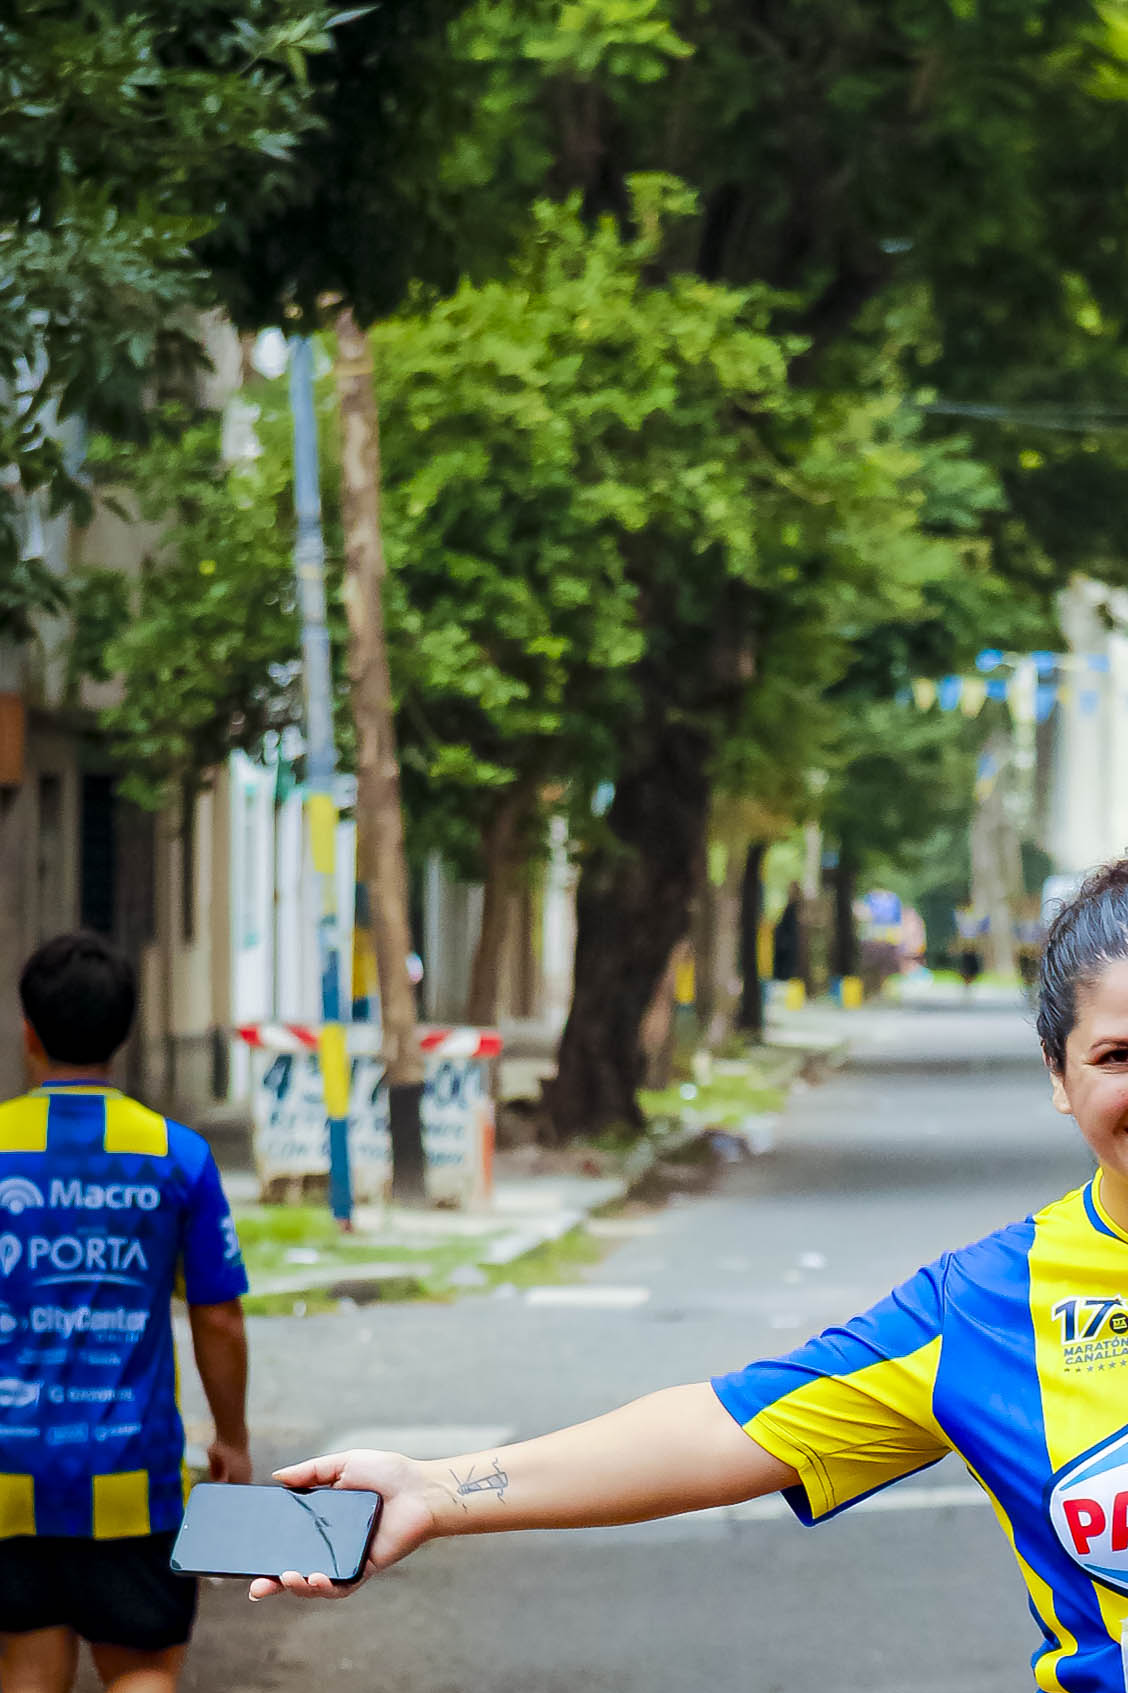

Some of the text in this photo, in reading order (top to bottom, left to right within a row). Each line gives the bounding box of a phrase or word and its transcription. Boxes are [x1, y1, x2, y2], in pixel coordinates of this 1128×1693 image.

[51, 1179, 160, 1210] Macro
[29, 1235, 149, 1271] PORTA
[1051, 1294, 1127, 1345] 17
